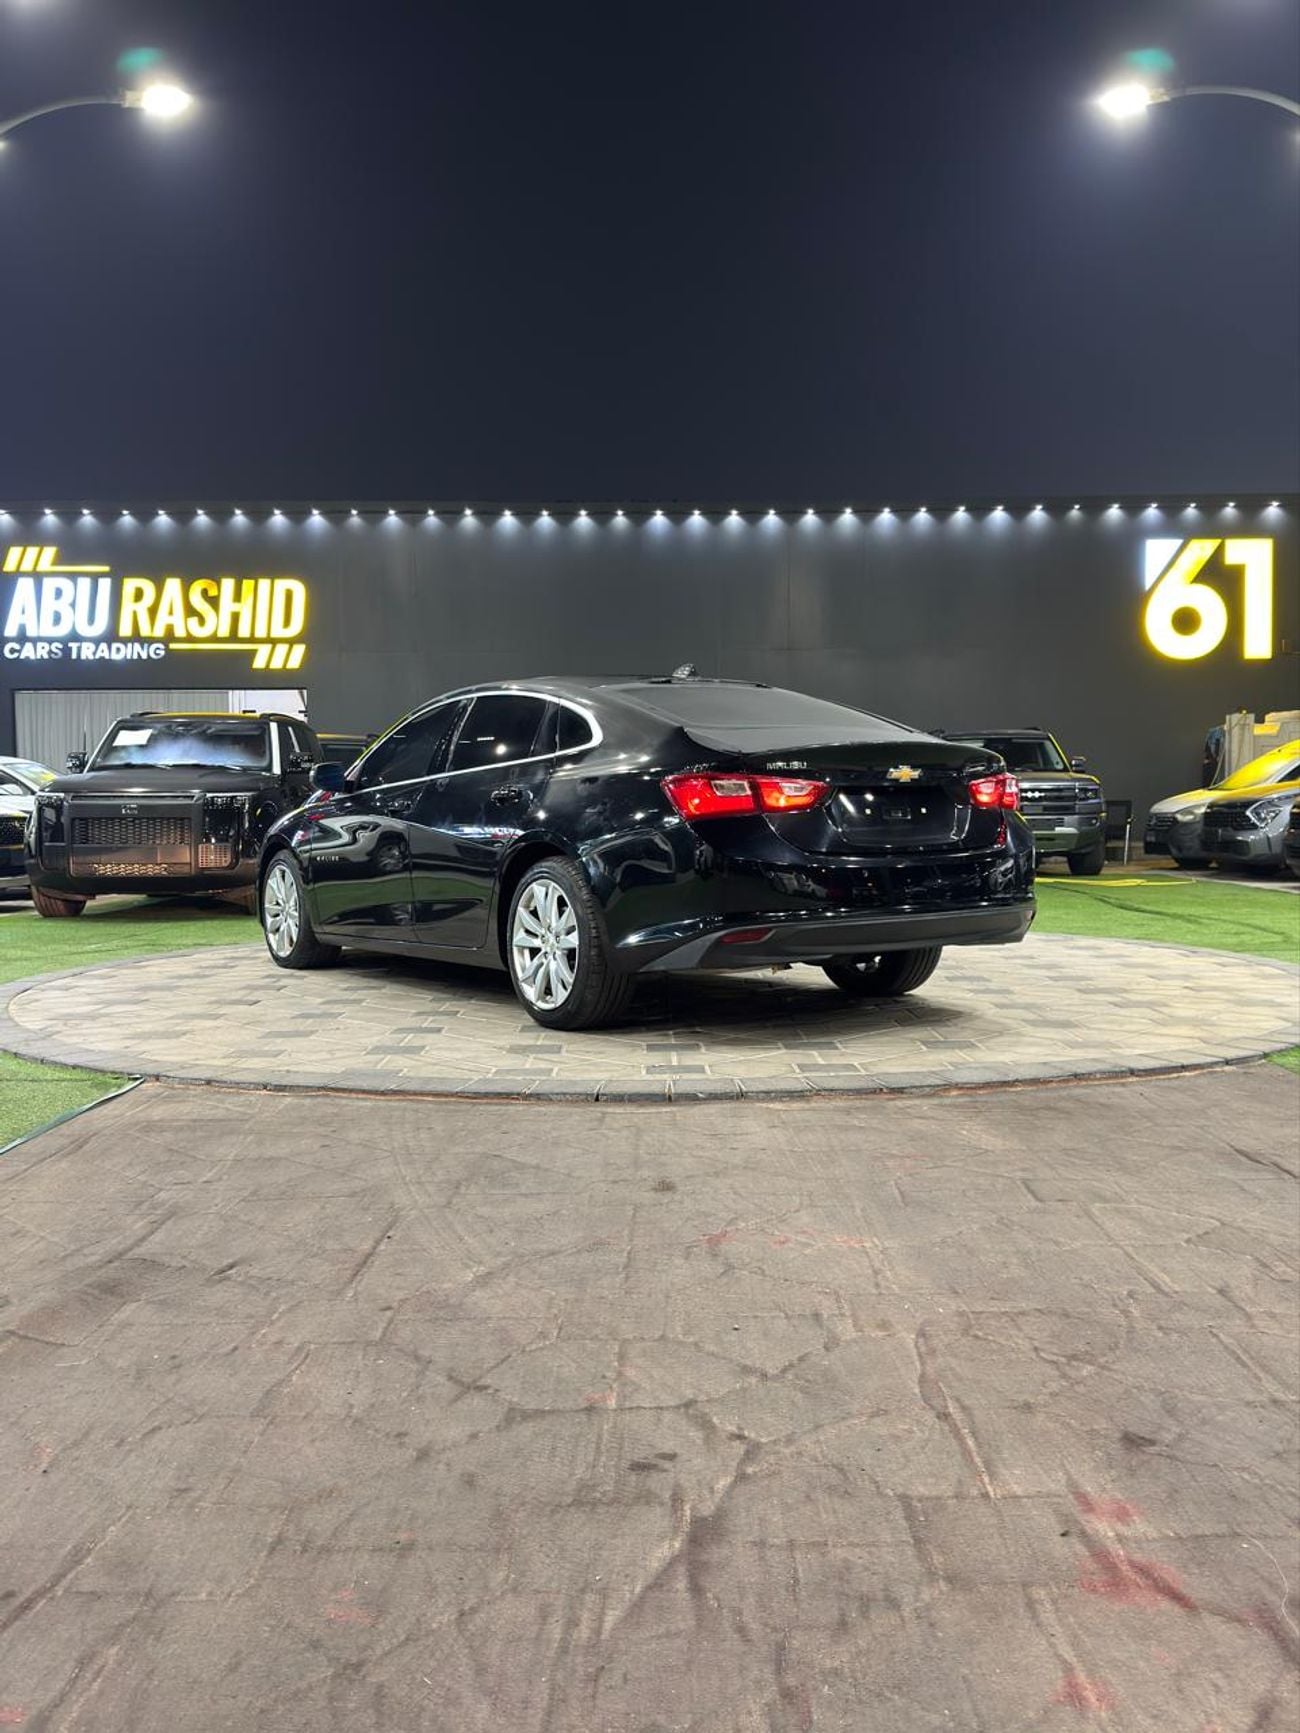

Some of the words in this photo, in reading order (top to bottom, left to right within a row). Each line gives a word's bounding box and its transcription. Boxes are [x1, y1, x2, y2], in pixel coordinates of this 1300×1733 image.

[3, 577, 111, 637] ABU
[118, 577, 306, 638] RASHID
[1144, 538, 1274, 660] 61
[3, 642, 63, 660] CARS
[68, 642, 166, 660] TRADING
